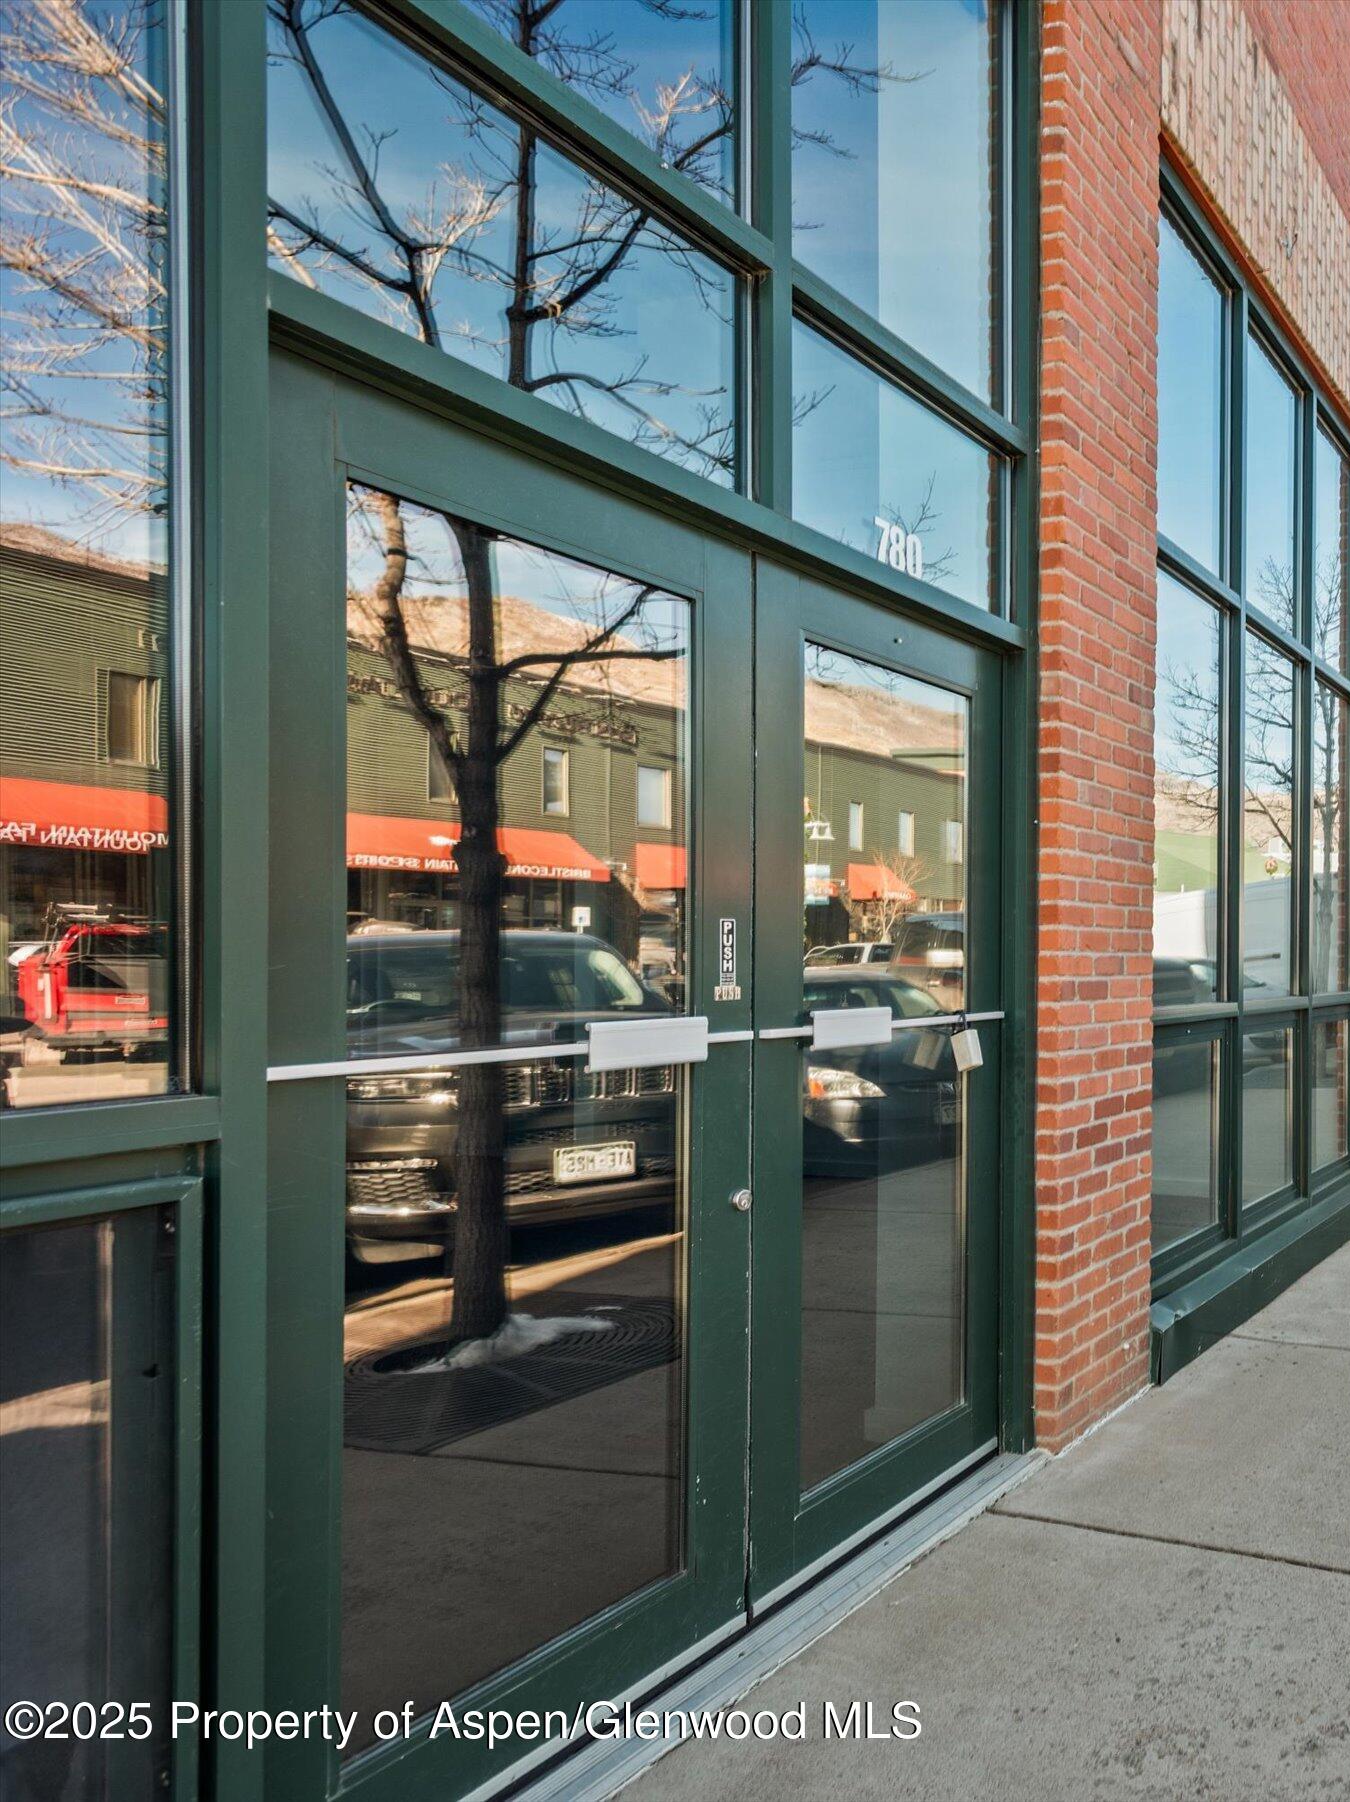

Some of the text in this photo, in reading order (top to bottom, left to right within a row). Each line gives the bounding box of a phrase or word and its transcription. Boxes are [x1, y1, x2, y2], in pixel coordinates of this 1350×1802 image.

[874, 515, 923, 580] 780
[723, 921, 733, 973] PUSH
[714, 986, 741, 1001] PUSH
